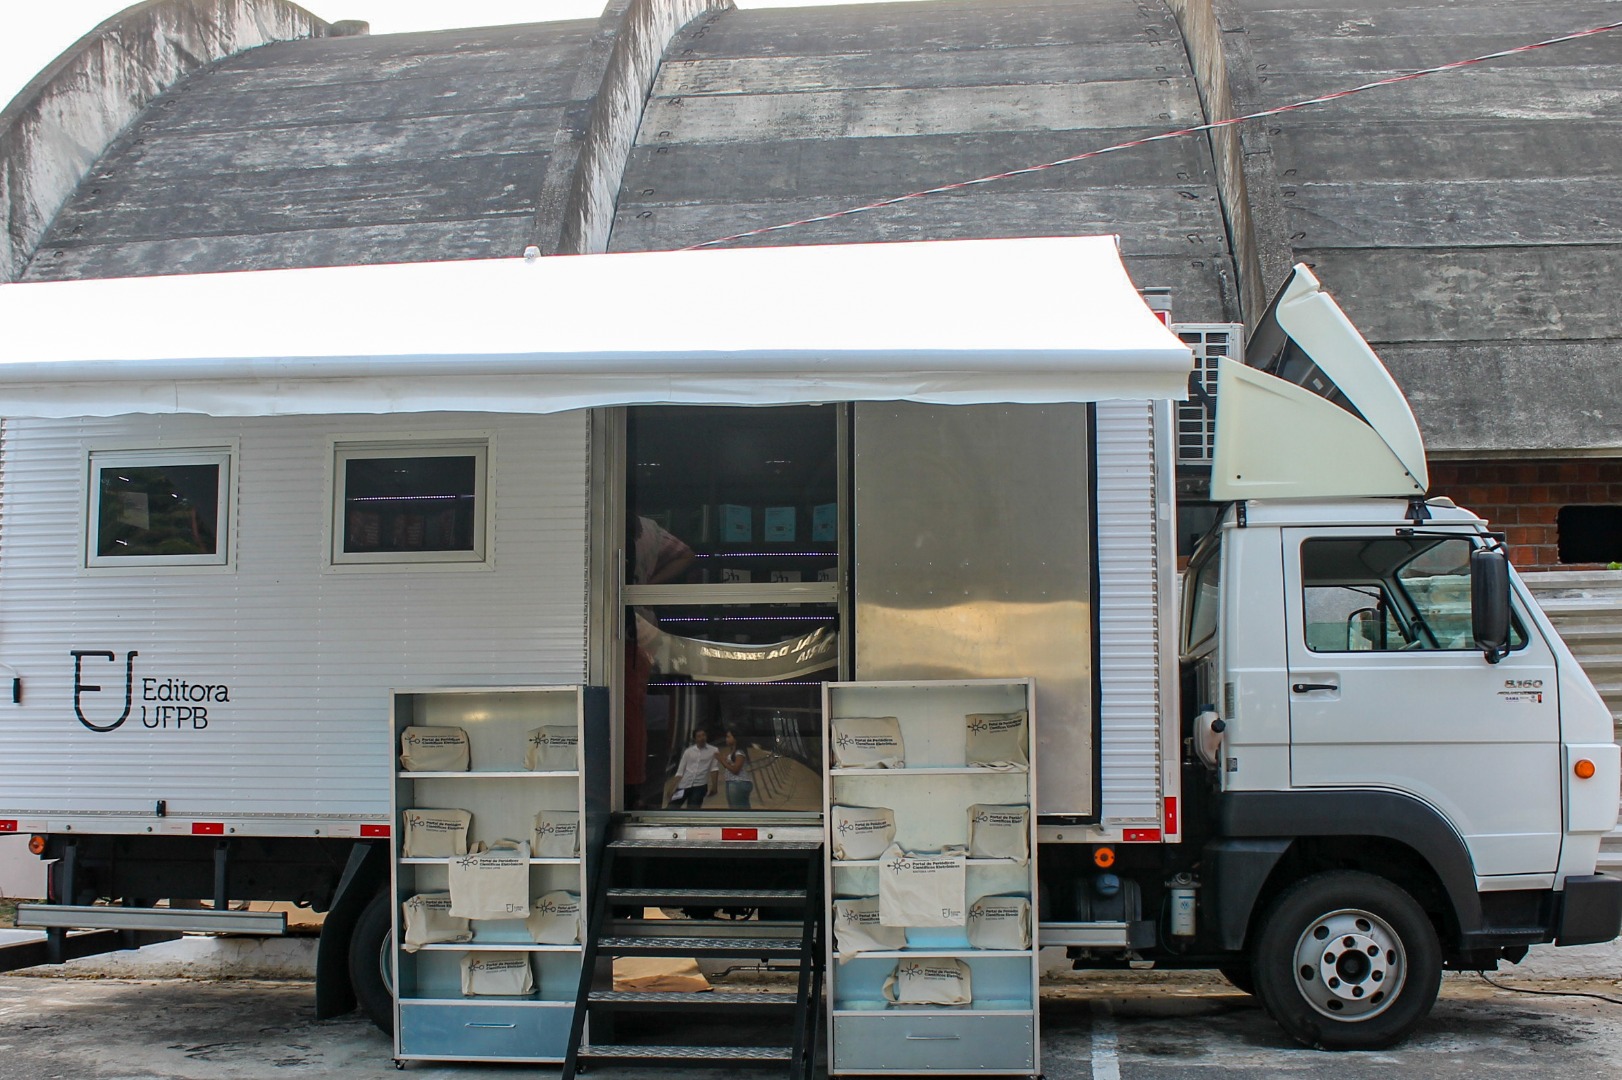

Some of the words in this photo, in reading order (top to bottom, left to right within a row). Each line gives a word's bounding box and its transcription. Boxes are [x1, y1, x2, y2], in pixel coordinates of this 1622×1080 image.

[142, 677, 230, 703] Editora
[1504, 679, 1543, 689] 8.160
[141, 705, 209, 729] UFPB
